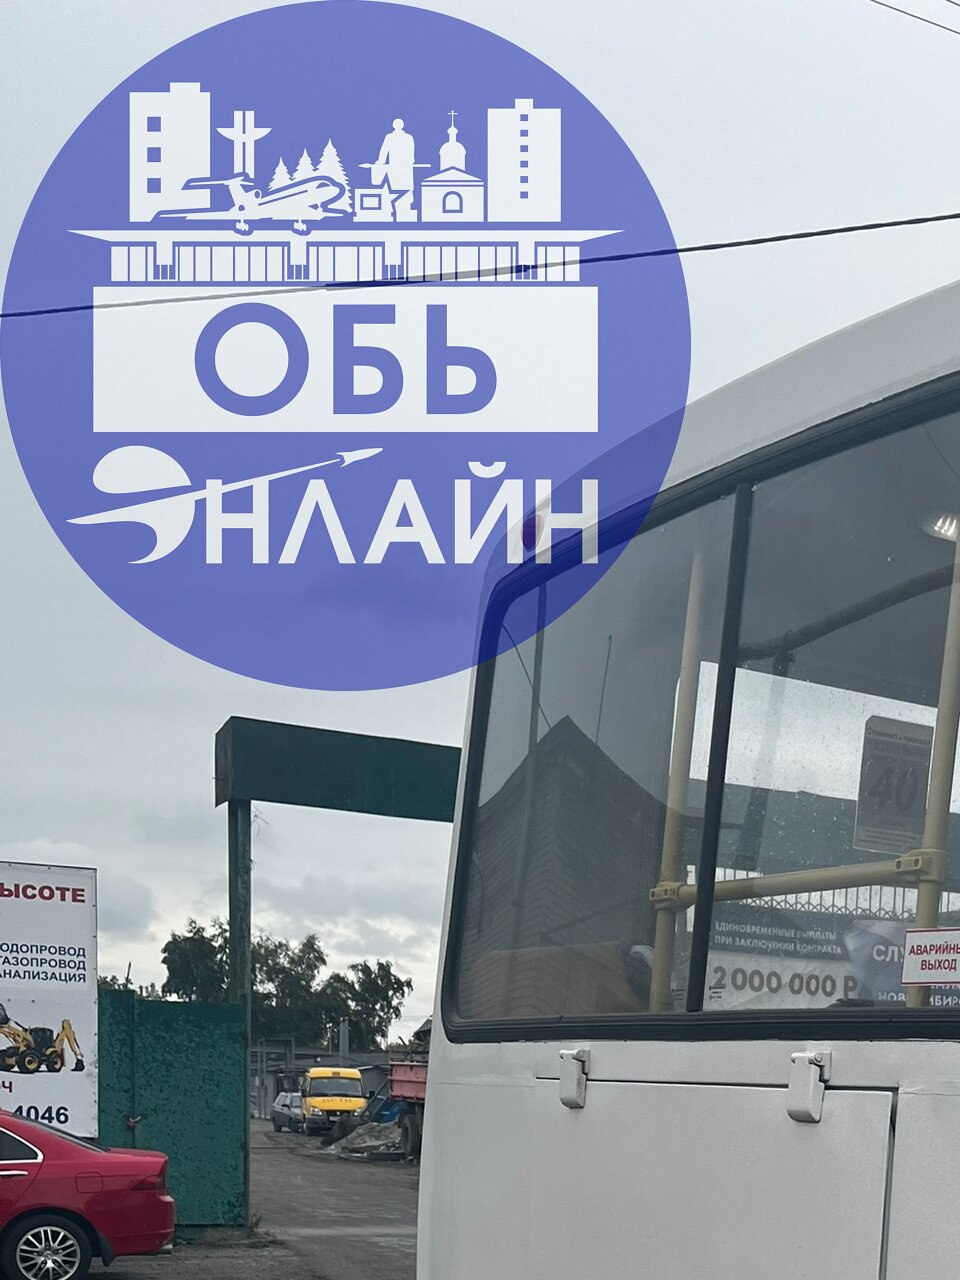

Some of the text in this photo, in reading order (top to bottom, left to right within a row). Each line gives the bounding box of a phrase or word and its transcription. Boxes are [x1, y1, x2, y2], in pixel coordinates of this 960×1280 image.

[714, 935, 733, 944] ПРИ
[920, 959, 958, 972] ВЫХОД
[0, 969, 86, 983] НАЛИЗАЦИЯ
[712, 966, 727, 989] 2
[731, 967, 782, 994] 000
[788, 972, 837, 997] 000
